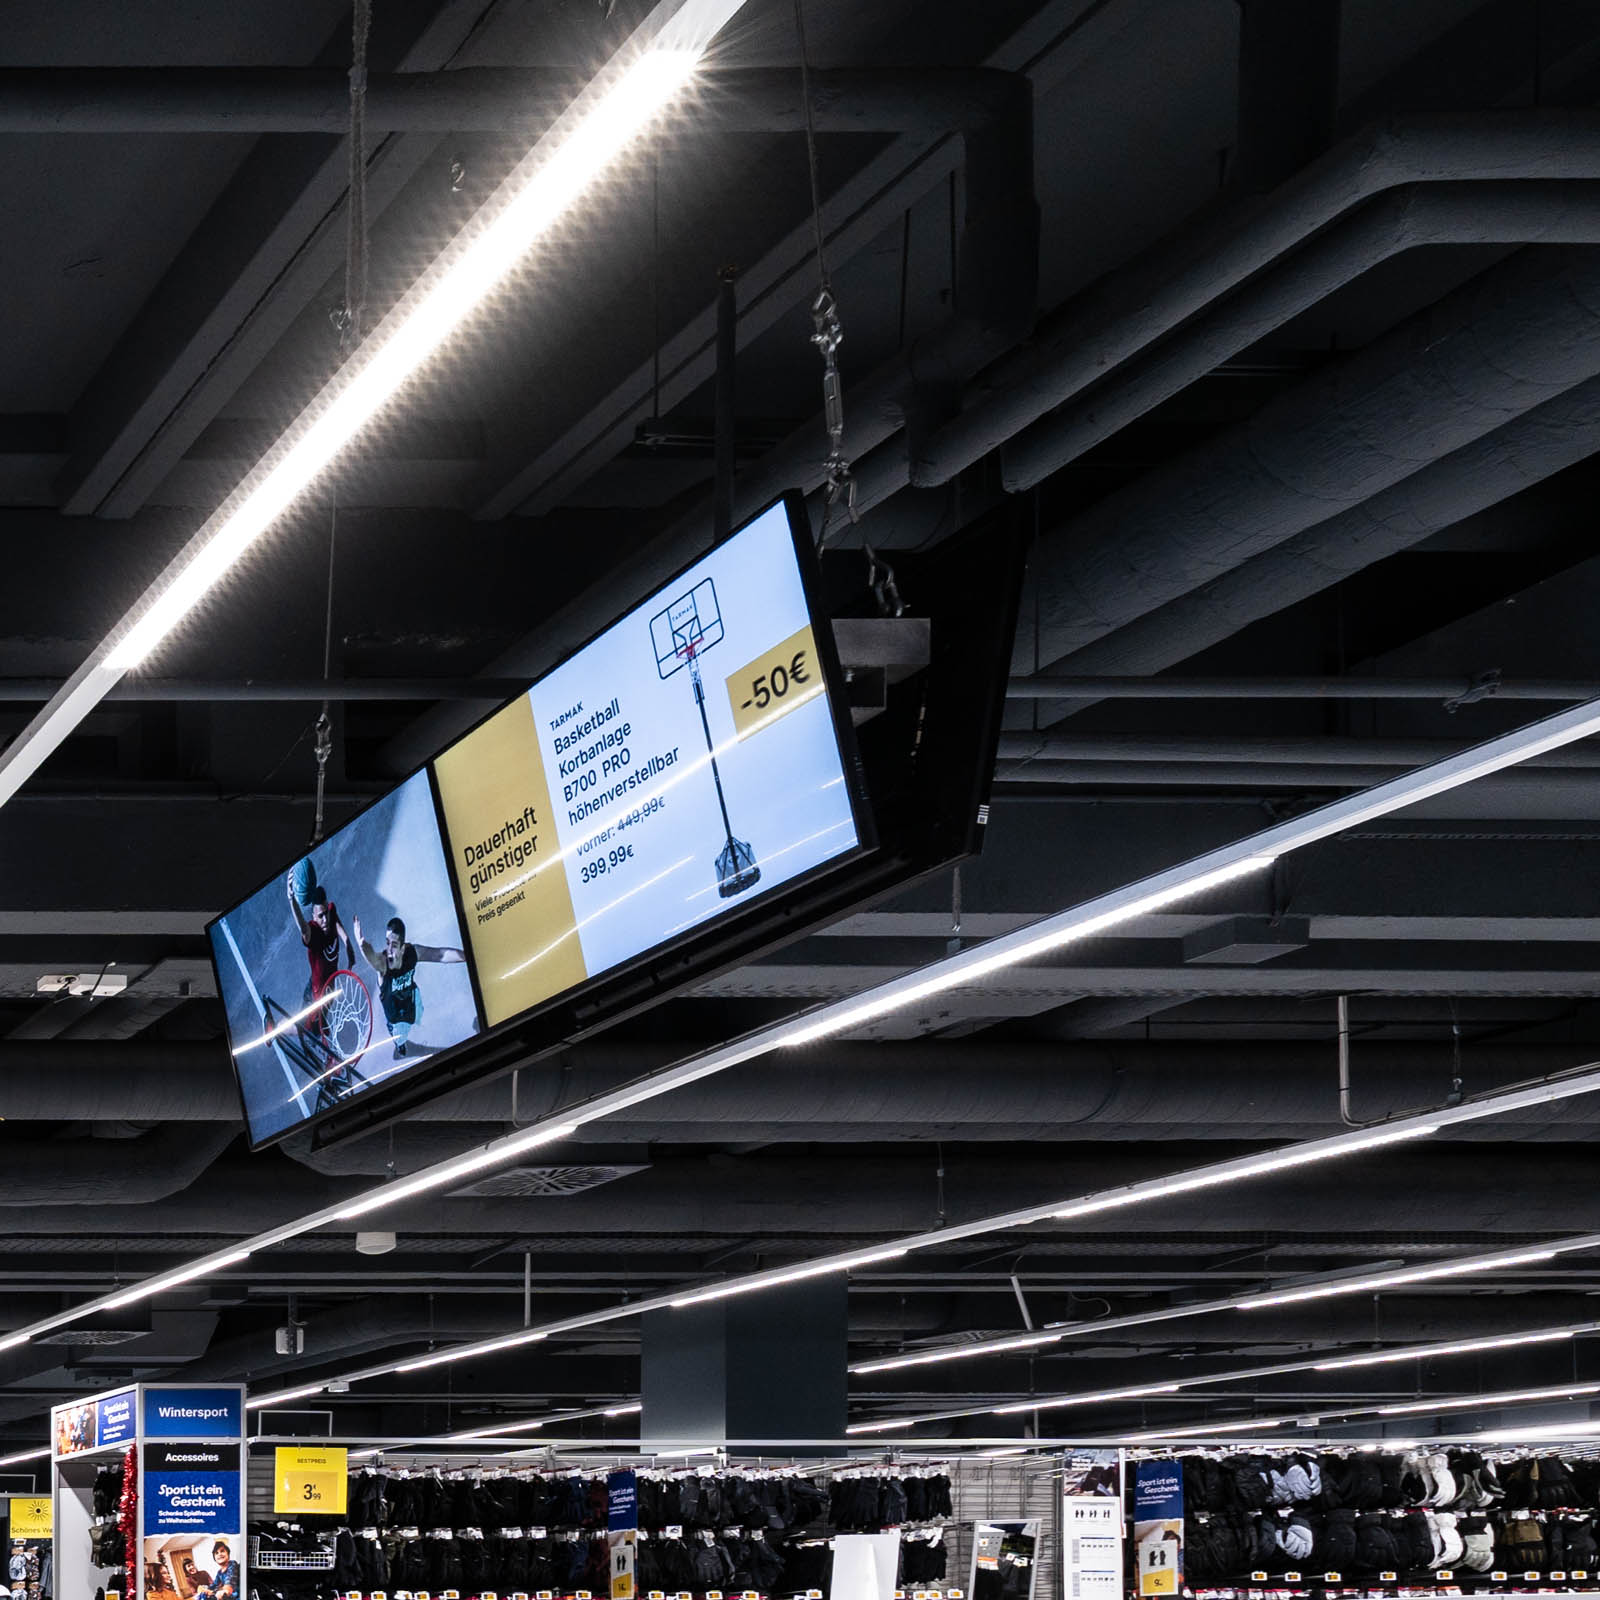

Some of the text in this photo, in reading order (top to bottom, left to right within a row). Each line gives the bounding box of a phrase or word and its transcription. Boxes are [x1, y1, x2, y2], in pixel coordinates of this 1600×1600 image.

[740, 650, 810, 708] -50€
[549, 701, 584, 731] TARMAK
[553, 698, 620, 754] Basketball
[558, 721, 632, 778] Korbanlage
[563, 748, 631, 802] B700 PRO
[568, 746, 679, 826] höhenverstellbar
[617, 796, 666, 831] 449,99€
[463, 806, 538, 867] Dauerhaft
[469, 833, 539, 894] günstiger
[580, 844, 634, 883] 399,99€
[475, 896, 493, 911] Viele
[477, 891, 526, 925] Preis gesenkt
[158, 1407, 228, 1420] Wintersport
[165, 1453, 220, 1462] Accessoires
[158, 1484, 223, 1498] Sport ist ein
[1137, 1479, 1156, 1488] Sport
[1144, 1485, 1180, 1494] Geschenk
[171, 1496, 226, 1507] Geschenk
[184, 1510, 216, 1518] Spielfreude
